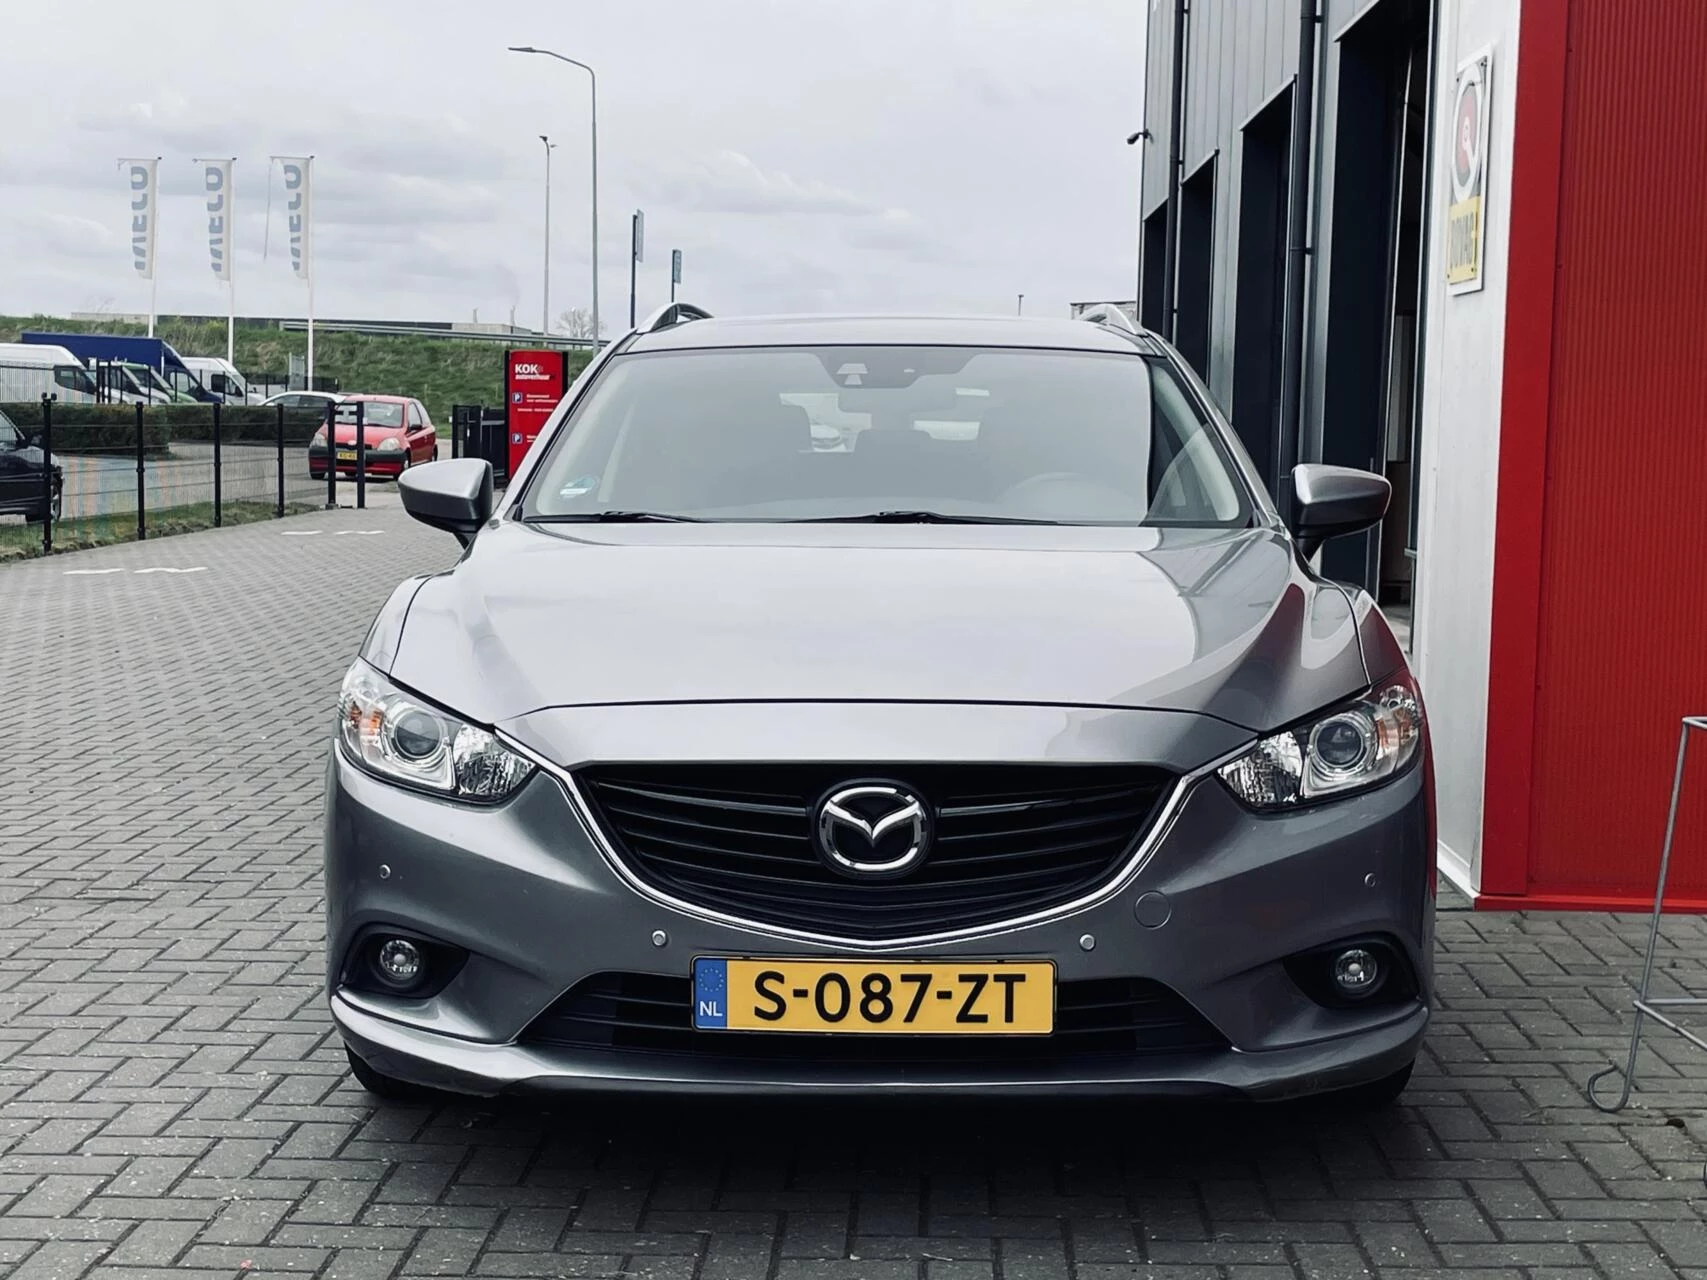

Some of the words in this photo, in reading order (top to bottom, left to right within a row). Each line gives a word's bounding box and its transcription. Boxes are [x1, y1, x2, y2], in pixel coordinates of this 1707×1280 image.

[515, 364, 538, 374] KOK
[753, 970, 1026, 1023] S-087-ZT
[699, 1001, 723, 1017] NL
